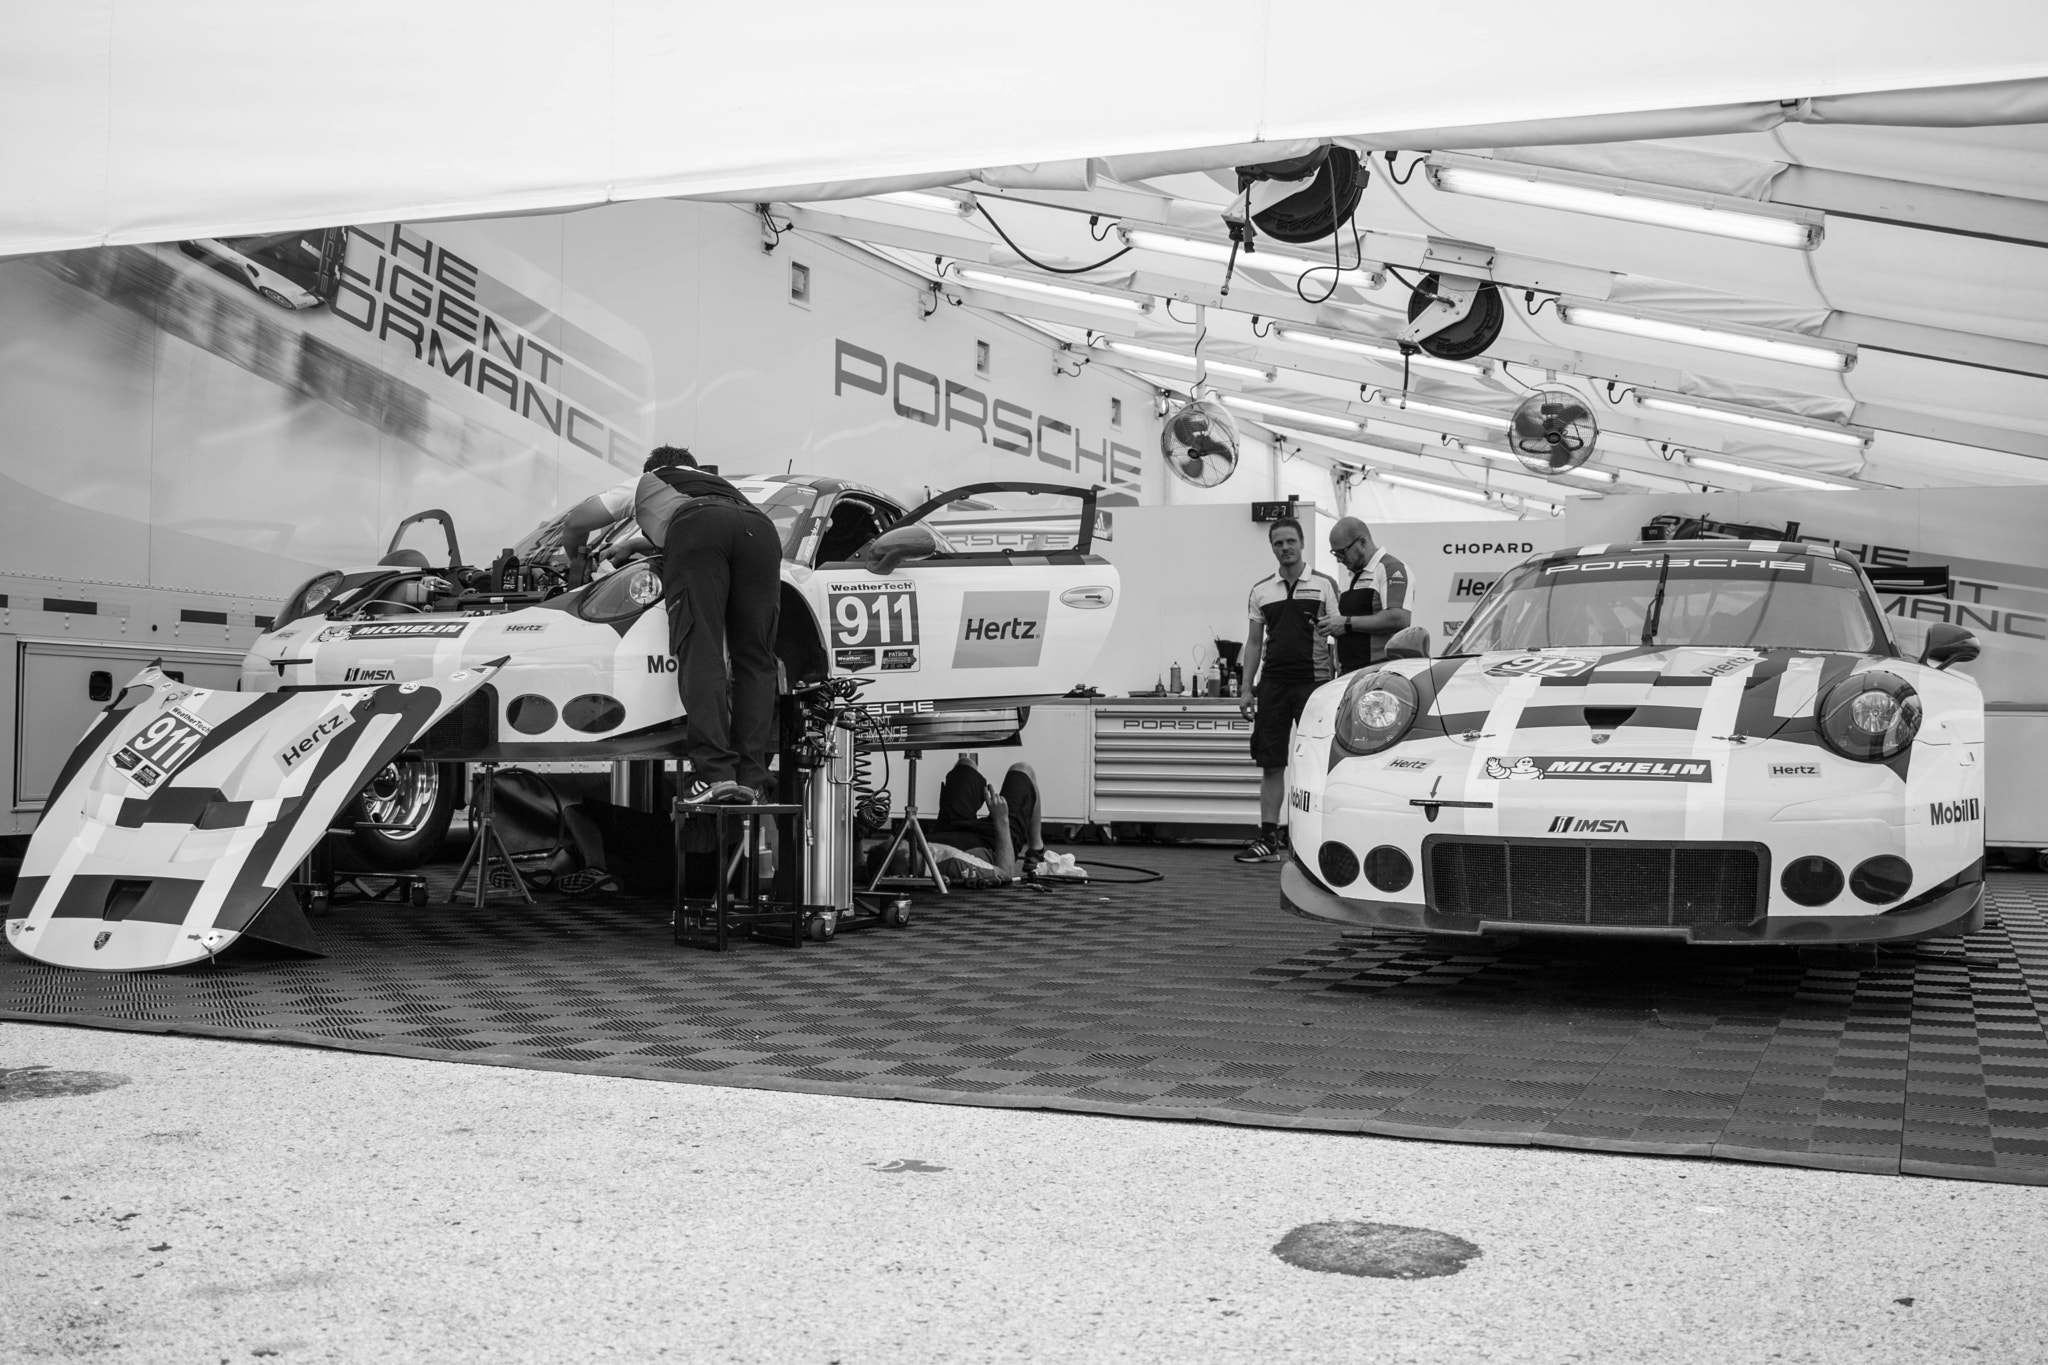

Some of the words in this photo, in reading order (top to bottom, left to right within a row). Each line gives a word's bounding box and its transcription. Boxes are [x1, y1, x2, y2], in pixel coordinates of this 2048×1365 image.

[835, 338, 1141, 493] PORSCHE
[1443, 543, 1533, 554] CHOPARD
[1545, 558, 1806, 575] PORSCHE
[831, 582, 912, 592] WeatherTech
[836, 595, 913, 644] 911
[355, 624, 464, 635] MICHELIN
[506, 624, 543, 632] Hertz
[964, 618, 1037, 640] Hertz
[1502, 657, 1586, 677] 912
[1702, 656, 1755, 677] Hertz
[360, 670, 395, 681] IMSA
[172, 706, 212, 734] WeatherTech
[1123, 720, 1250, 730] PORSCHE
[134, 717, 203, 769] 911
[281, 714, 344, 767] Hertz
[1390, 759, 1427, 769] Hertz
[1545, 761, 1706, 775] MICHELIN
[1773, 766, 1816, 774] Hertz
[1573, 820, 1629, 833] IMSA
